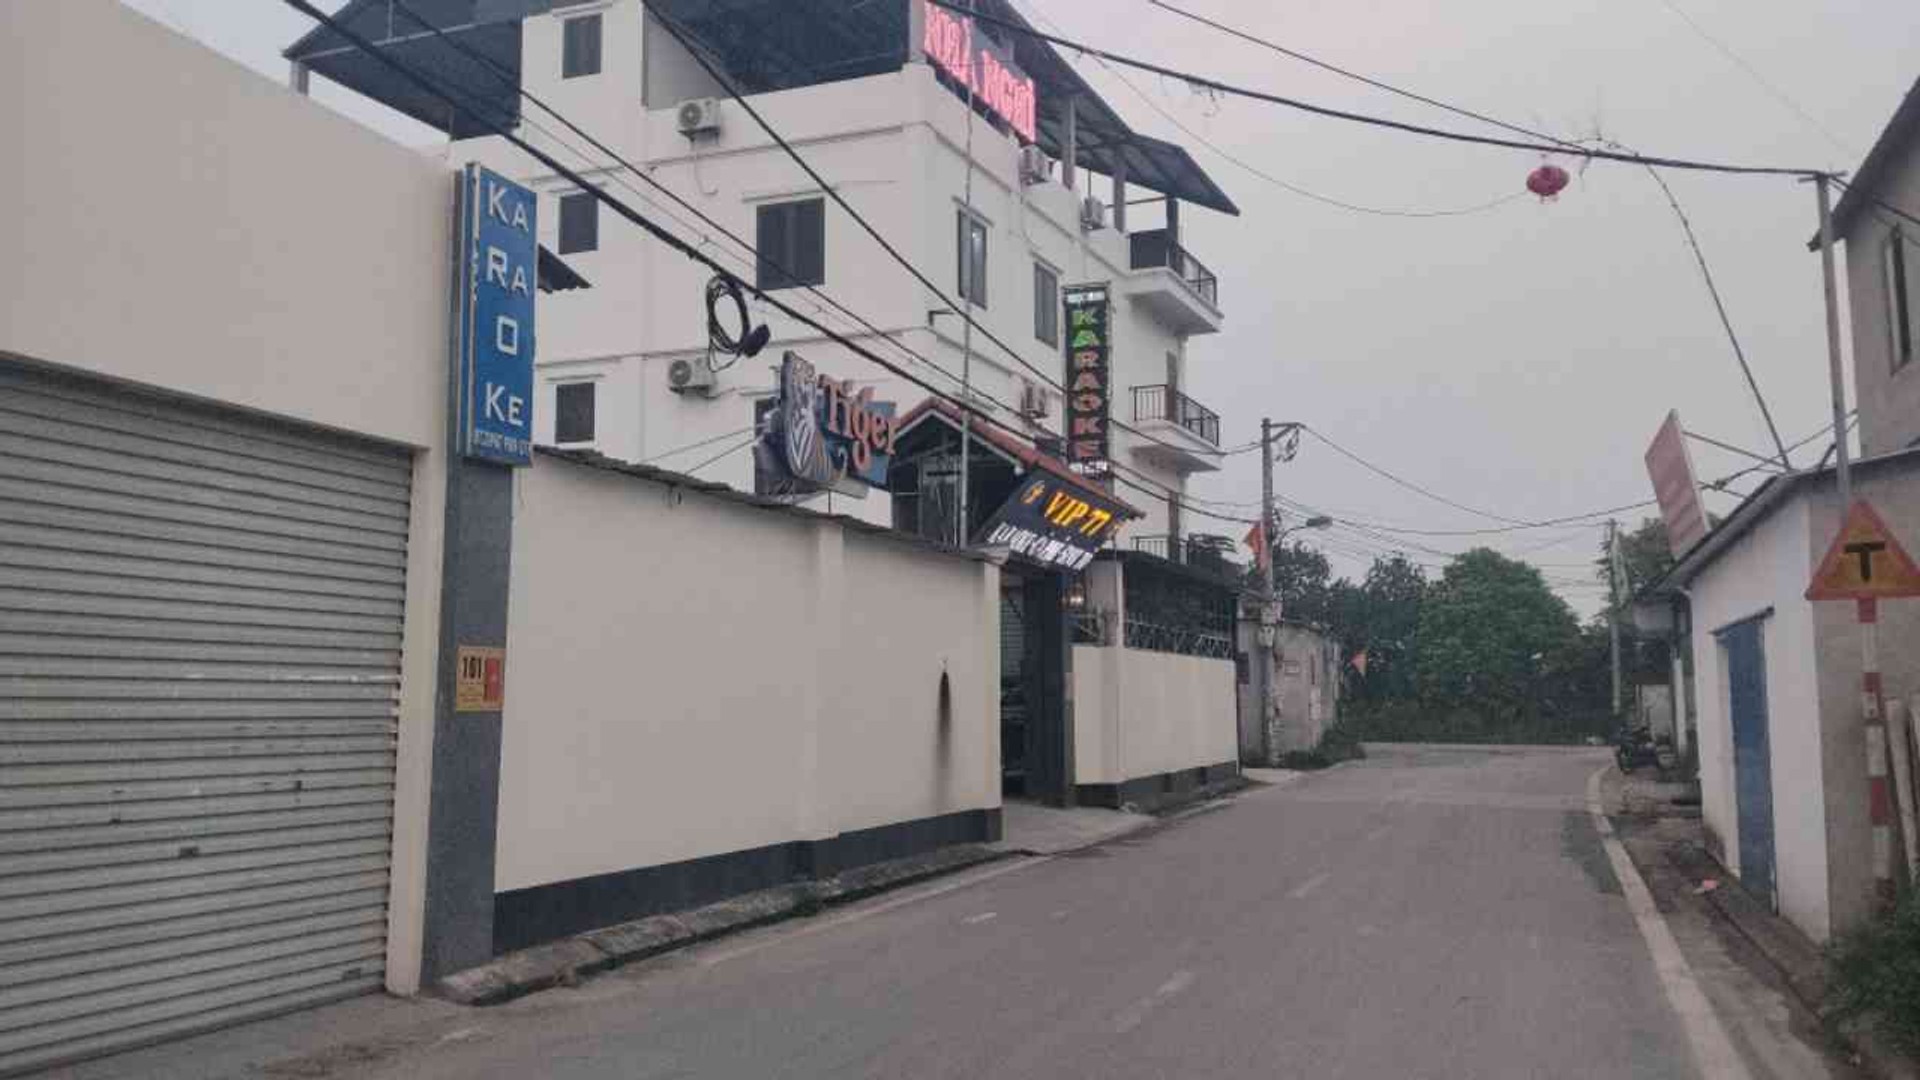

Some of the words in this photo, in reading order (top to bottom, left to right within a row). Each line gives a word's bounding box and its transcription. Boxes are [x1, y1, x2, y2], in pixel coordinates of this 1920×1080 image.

[818, 374, 897, 472] Tiger
[1072, 310, 1103, 458] KARAOKE
[463, 656, 481, 679] 101
